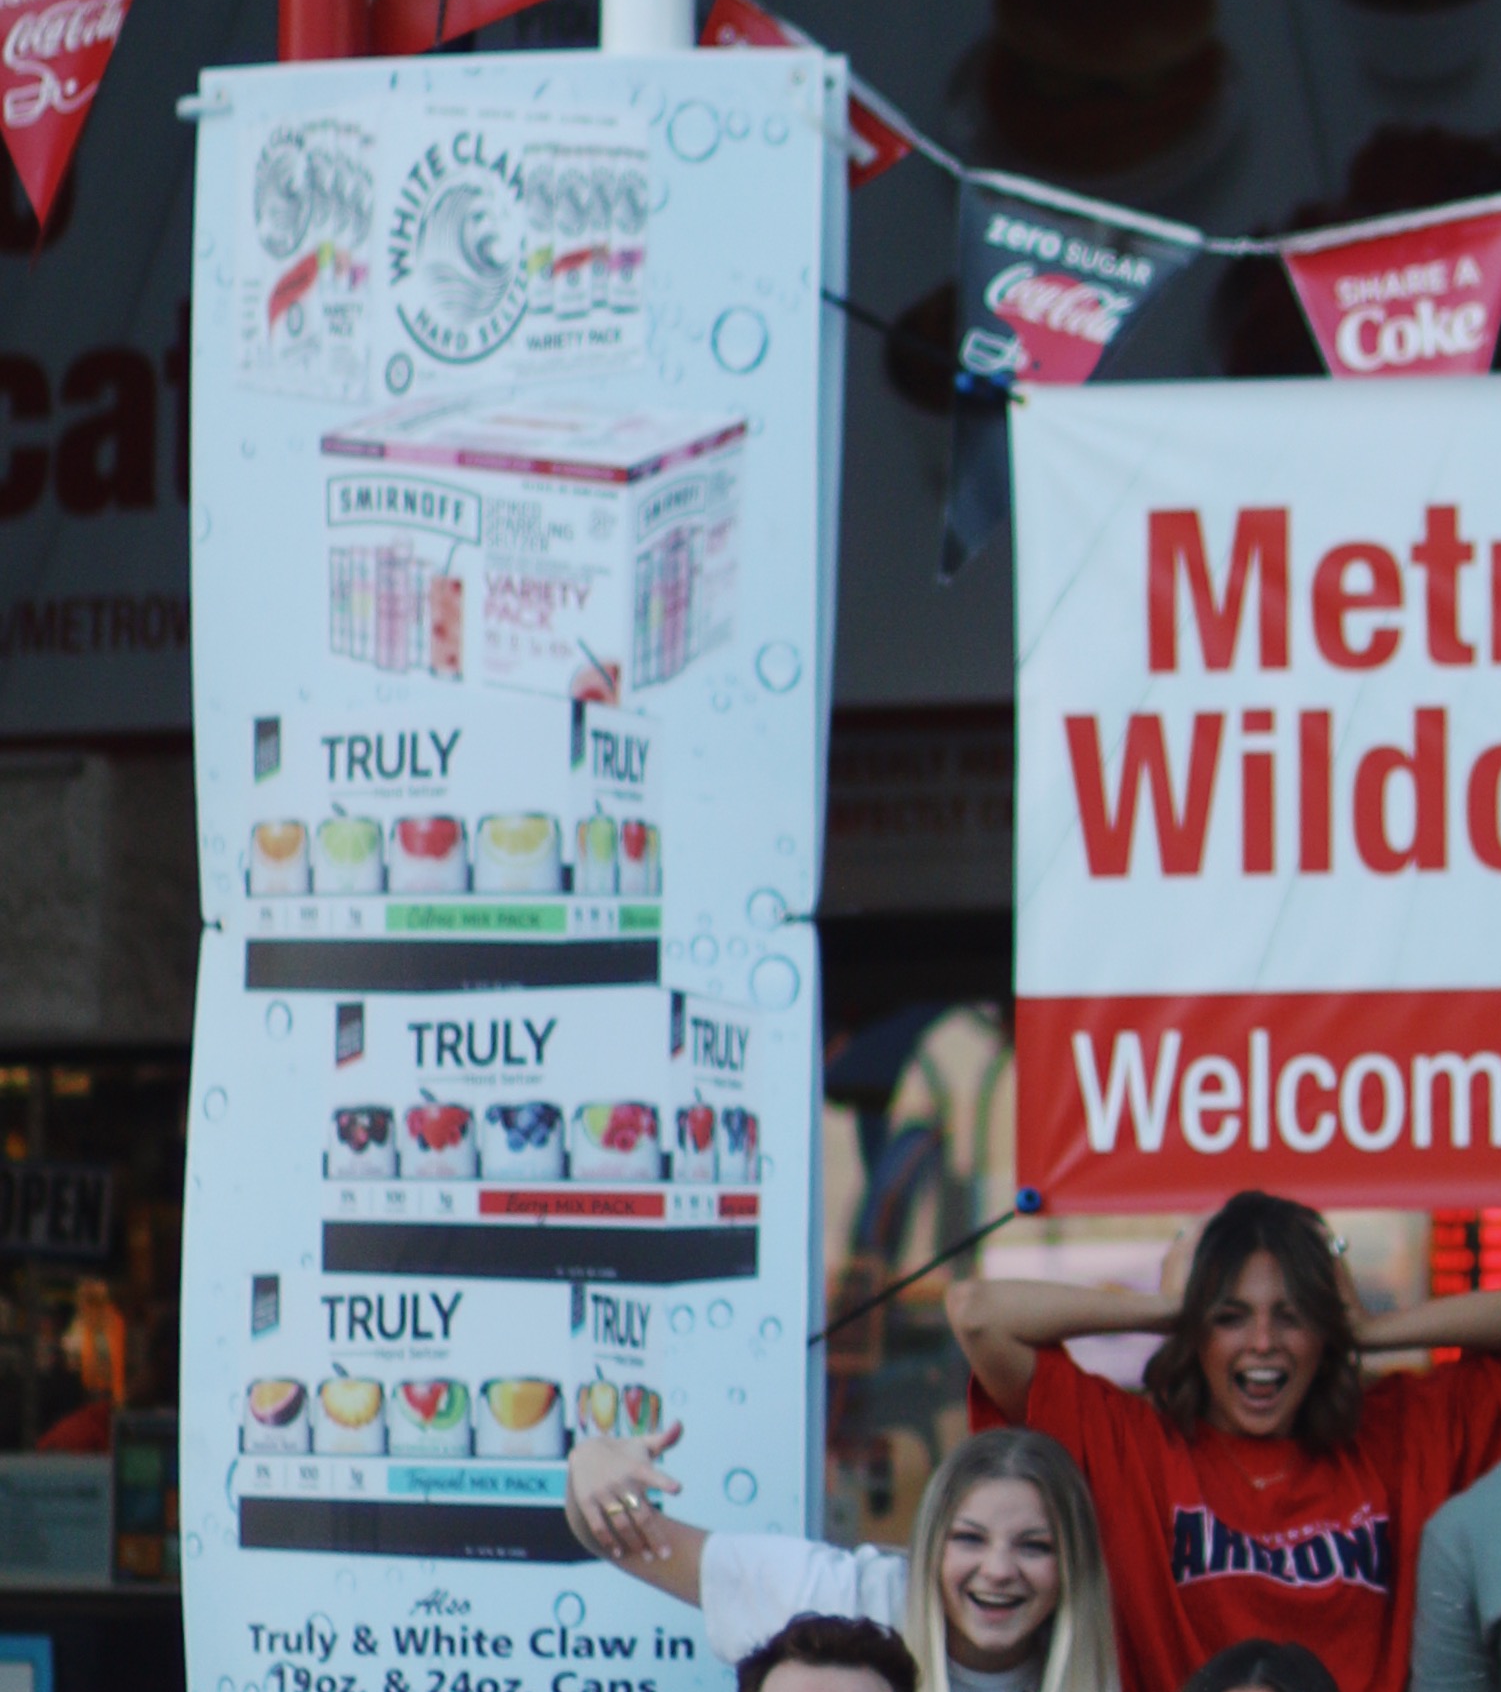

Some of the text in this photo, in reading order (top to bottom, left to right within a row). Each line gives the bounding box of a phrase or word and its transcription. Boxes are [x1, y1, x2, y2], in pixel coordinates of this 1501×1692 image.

[389, 143, 445, 286] WHITE
[985, 213, 1155, 288] zero SUGAR
[1334, 253, 1482, 310] SHARE A
[1336, 298, 1490, 373] Coke
[340, 485, 464, 529] SMIRNOFF
[484, 573, 590, 611] VARIETY
[321, 728, 461, 784] TRULY
[591, 729, 650, 785] TRULY
[407, 1017, 559, 1069] TRULY
[690, 1015, 749, 1074] TRULY
[553, 1196, 588, 1216] MIX
[590, 1198, 636, 1217] PACK
[320, 1289, 464, 1342] TRULY
[591, 1291, 651, 1351] TRULY
[248, 1622, 697, 1663] Truly & White Claw in
